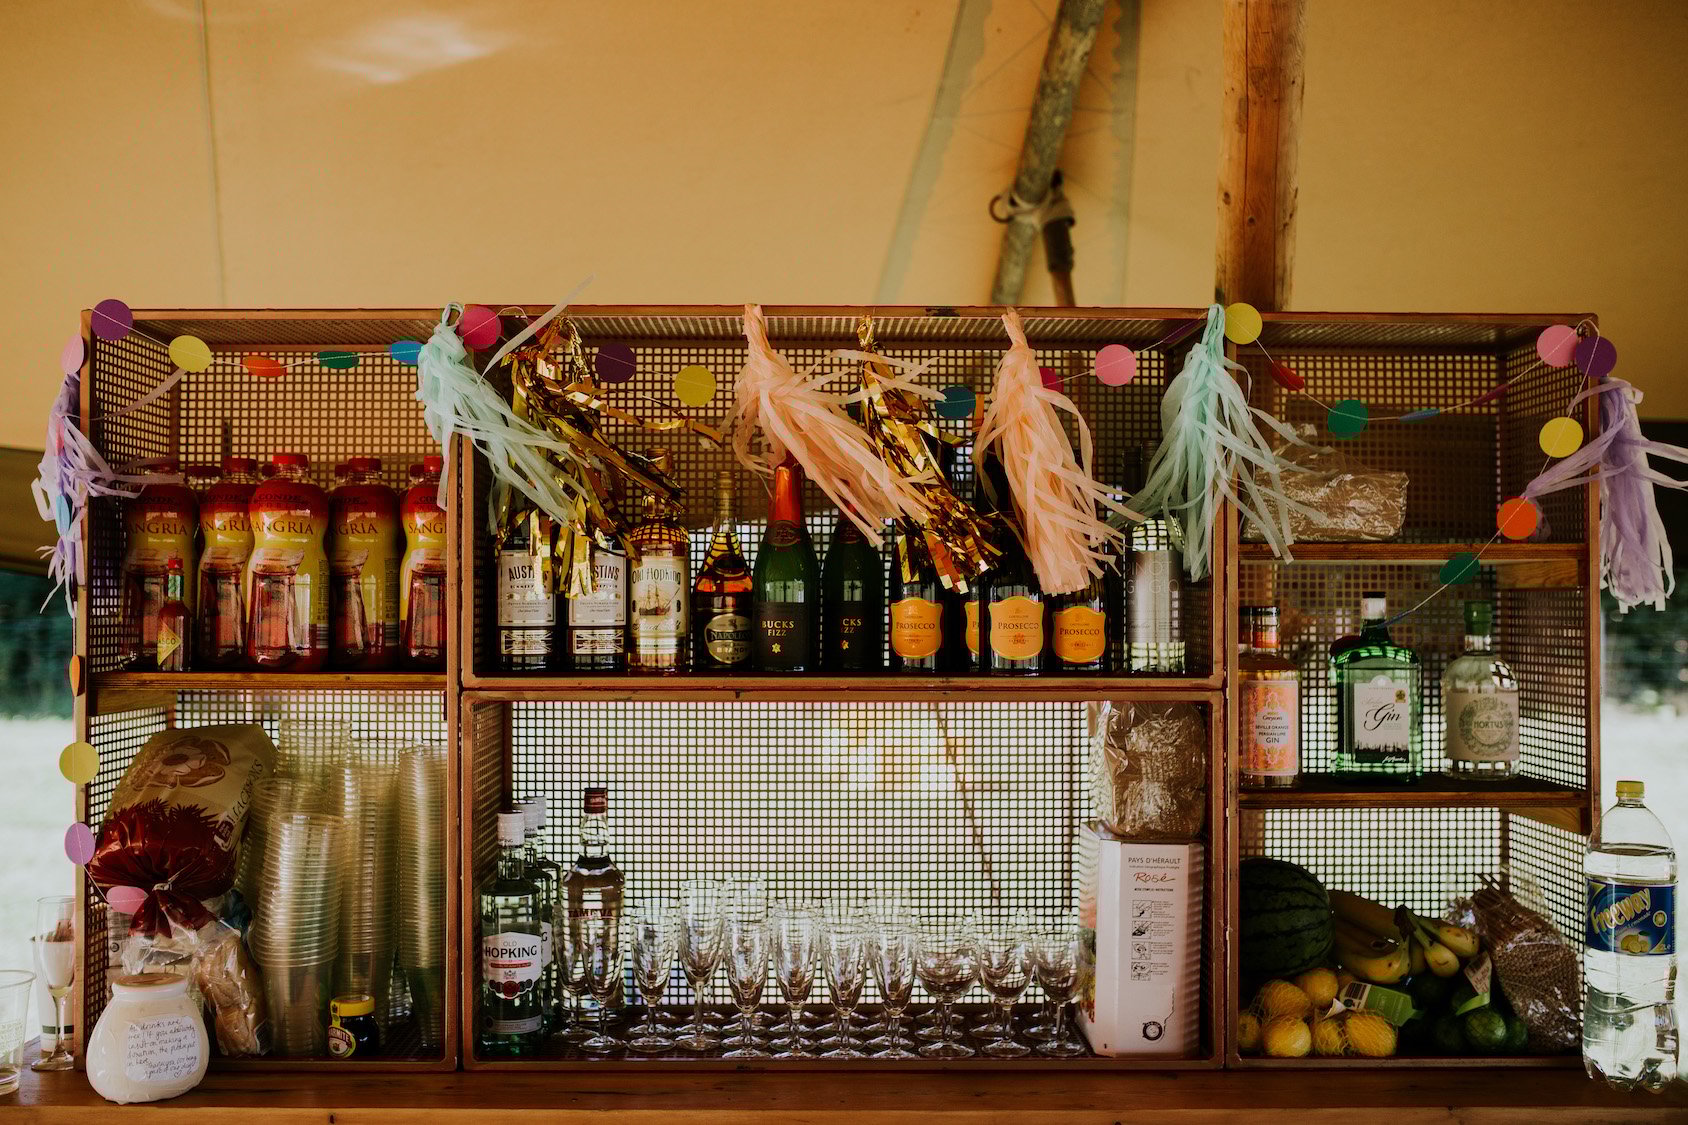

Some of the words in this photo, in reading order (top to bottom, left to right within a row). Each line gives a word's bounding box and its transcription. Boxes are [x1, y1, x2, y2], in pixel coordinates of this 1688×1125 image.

[762, 620, 795, 629] BUCKS
[896, 622, 936, 630] PROSECCO
[998, 622, 1040, 630] PROSECCO
[768, 629, 787, 637] FIZZ
[1060, 627, 1100, 636] PROSECCO
[1364, 703, 1401, 731] Gin
[1134, 872, 1176, 884] Rosé
[1590, 888, 1651, 935] Freeway
[486, 945, 537, 959] HOPKING
